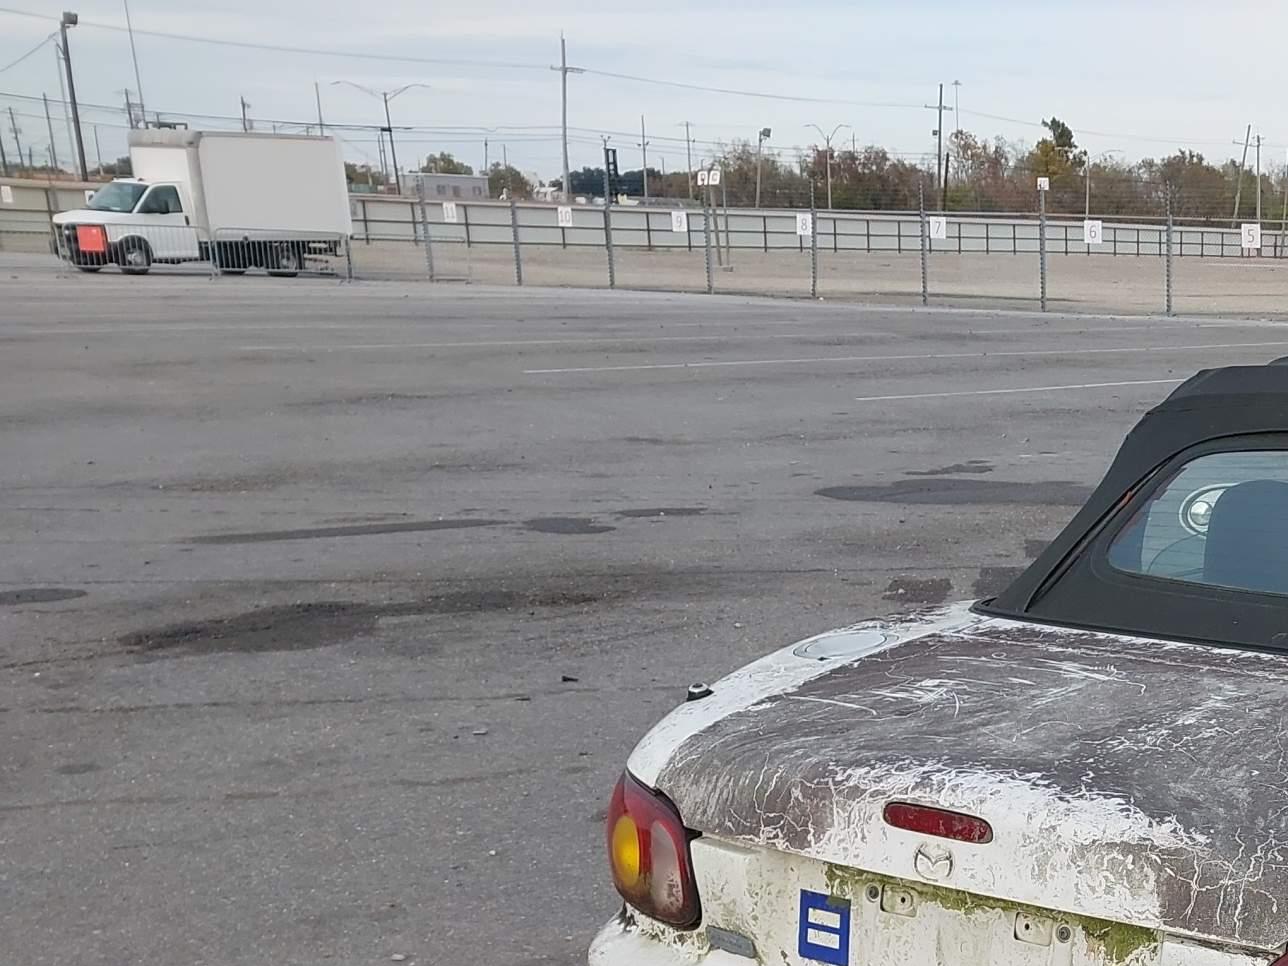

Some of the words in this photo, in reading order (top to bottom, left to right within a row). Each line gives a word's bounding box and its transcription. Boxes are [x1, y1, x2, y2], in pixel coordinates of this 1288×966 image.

[801, 218, 808, 231] 8
[935, 221, 942, 235] 7
[1089, 224, 1097, 239] 6
[1247, 228, 1255, 243] 5
